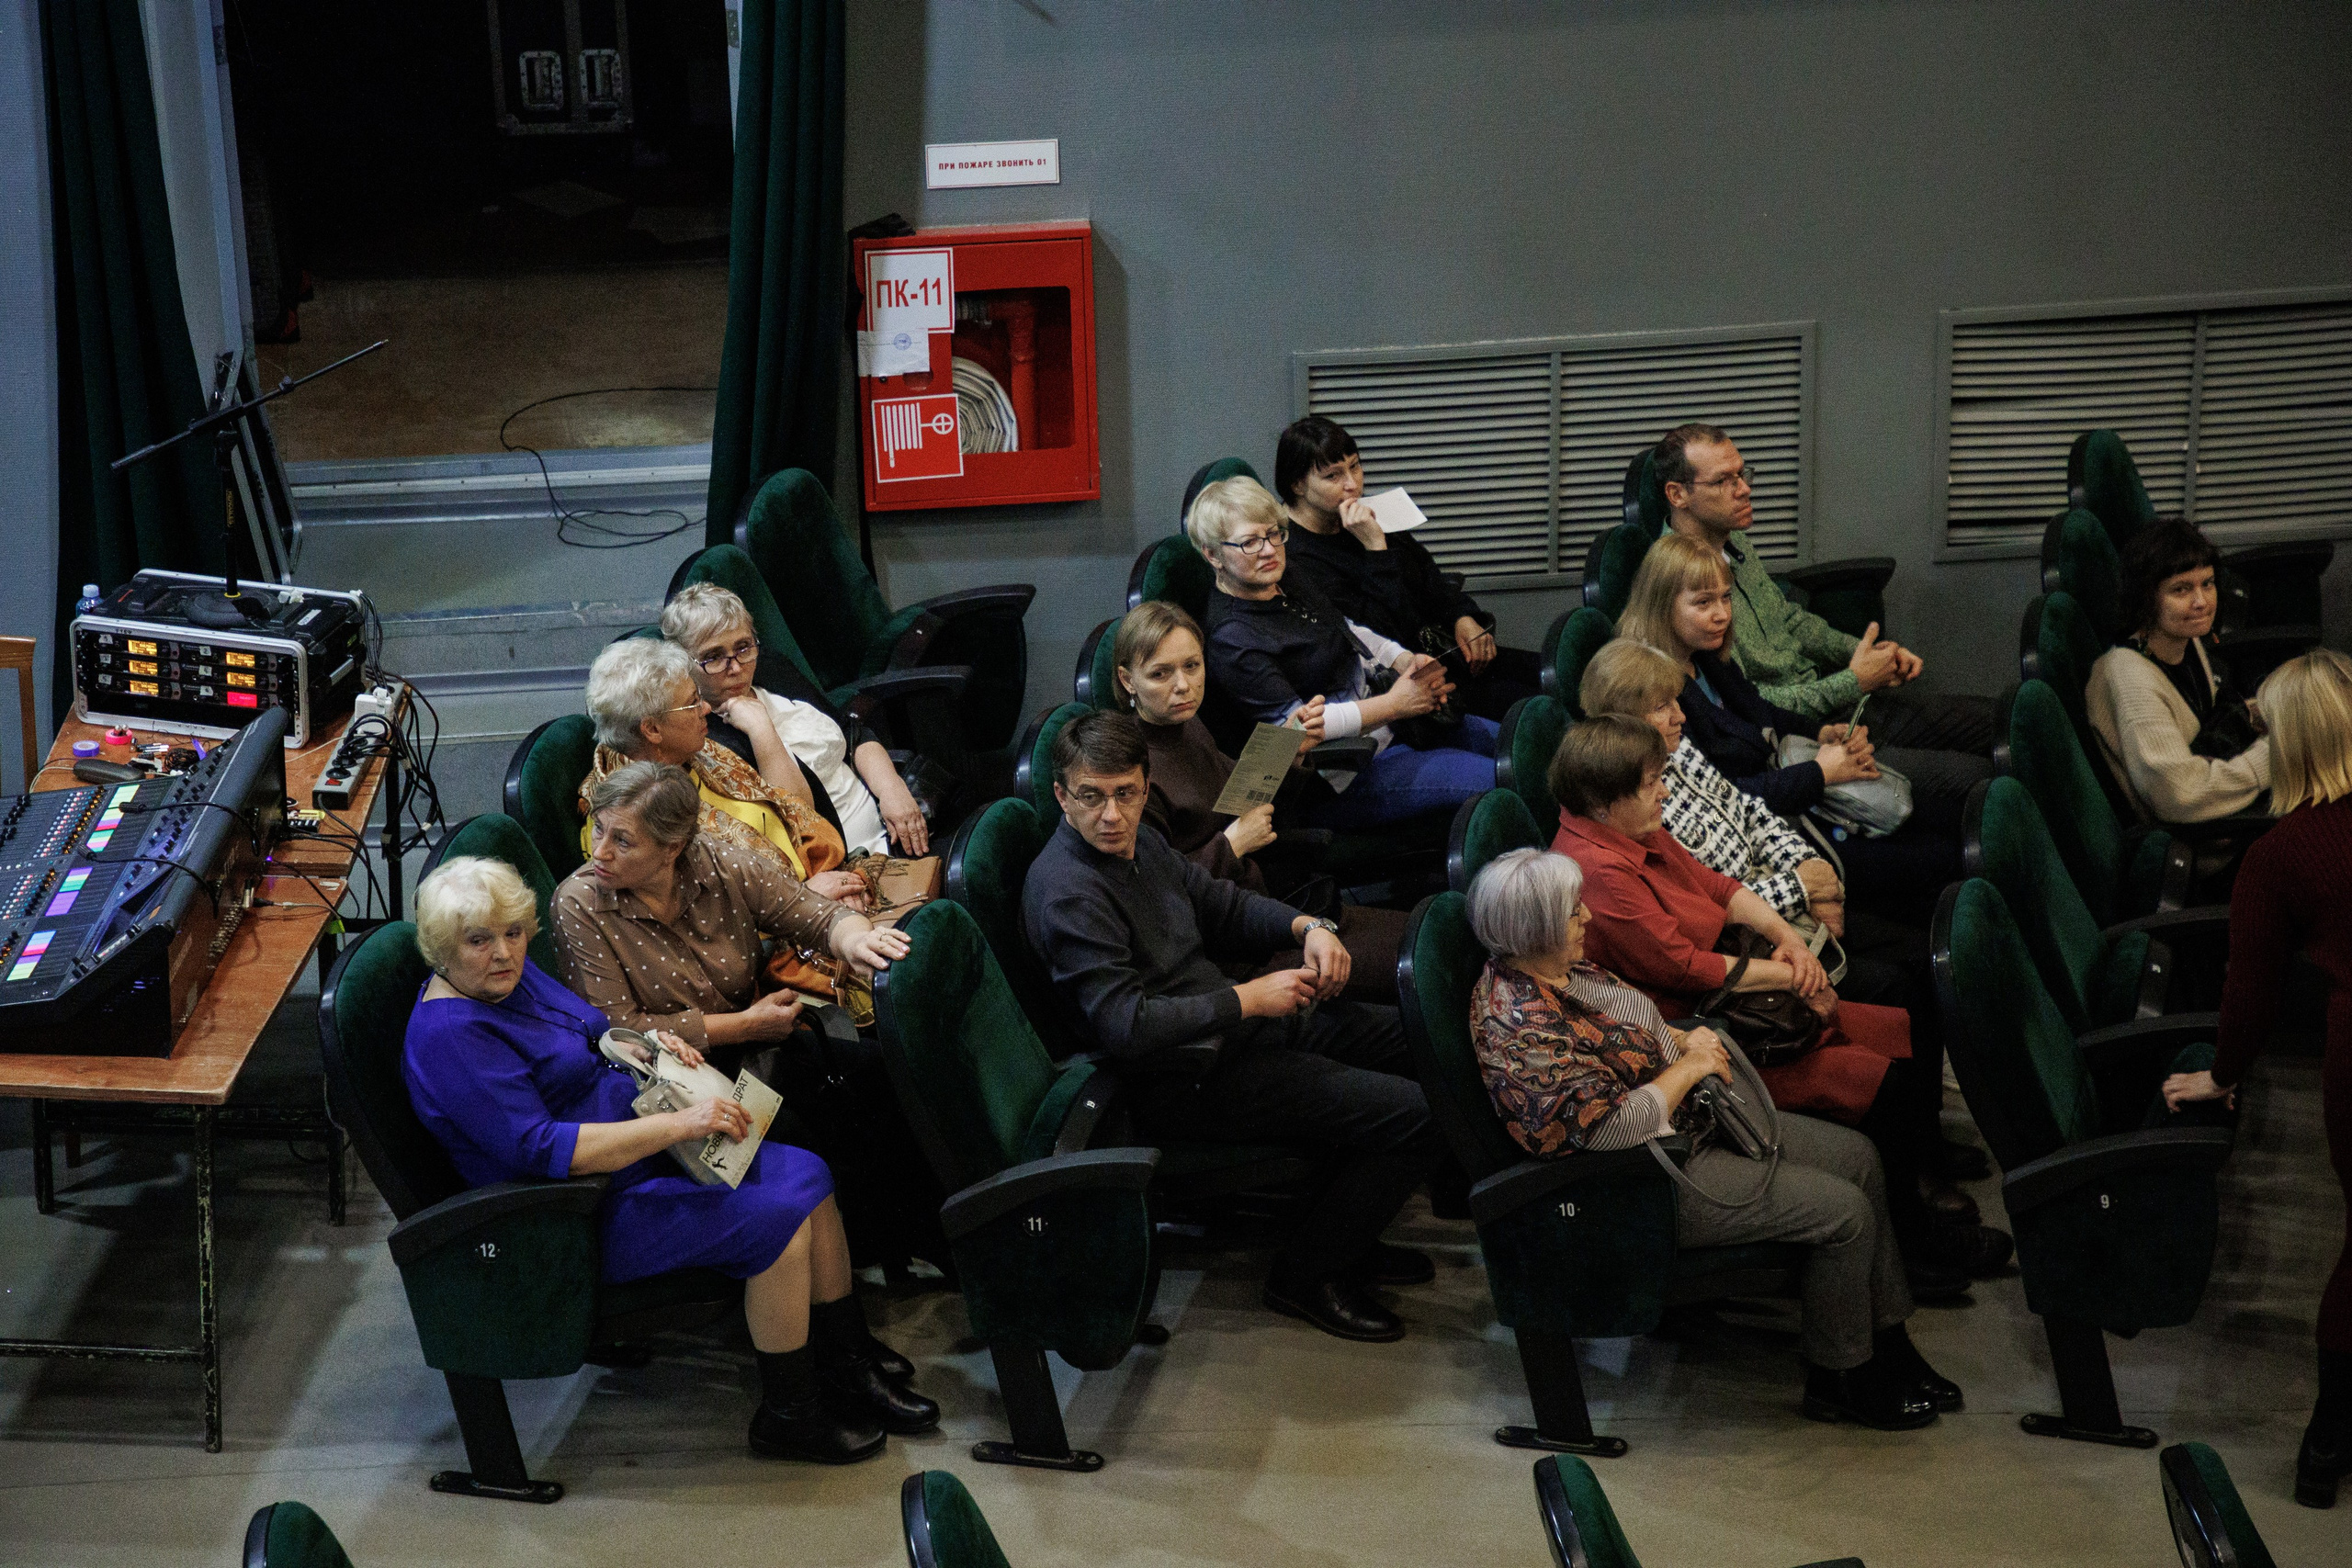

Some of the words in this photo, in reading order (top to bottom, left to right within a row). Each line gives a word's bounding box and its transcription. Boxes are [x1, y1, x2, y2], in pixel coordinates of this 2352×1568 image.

[958, 161, 993, 169] ПОЖАРЕ
[997, 159, 1034, 167] ЗВОНИТЬ
[876, 277, 942, 309] ПК-11
[702, 1132, 729, 1164] НОВЫ
[732, 1076, 749, 1103] ДРАТ
[2100, 1194, 2109, 1209] 9
[1558, 1202, 1575, 1217] 10
[1028, 1217, 1042, 1232] 11
[480, 1243, 496, 1258] 12
